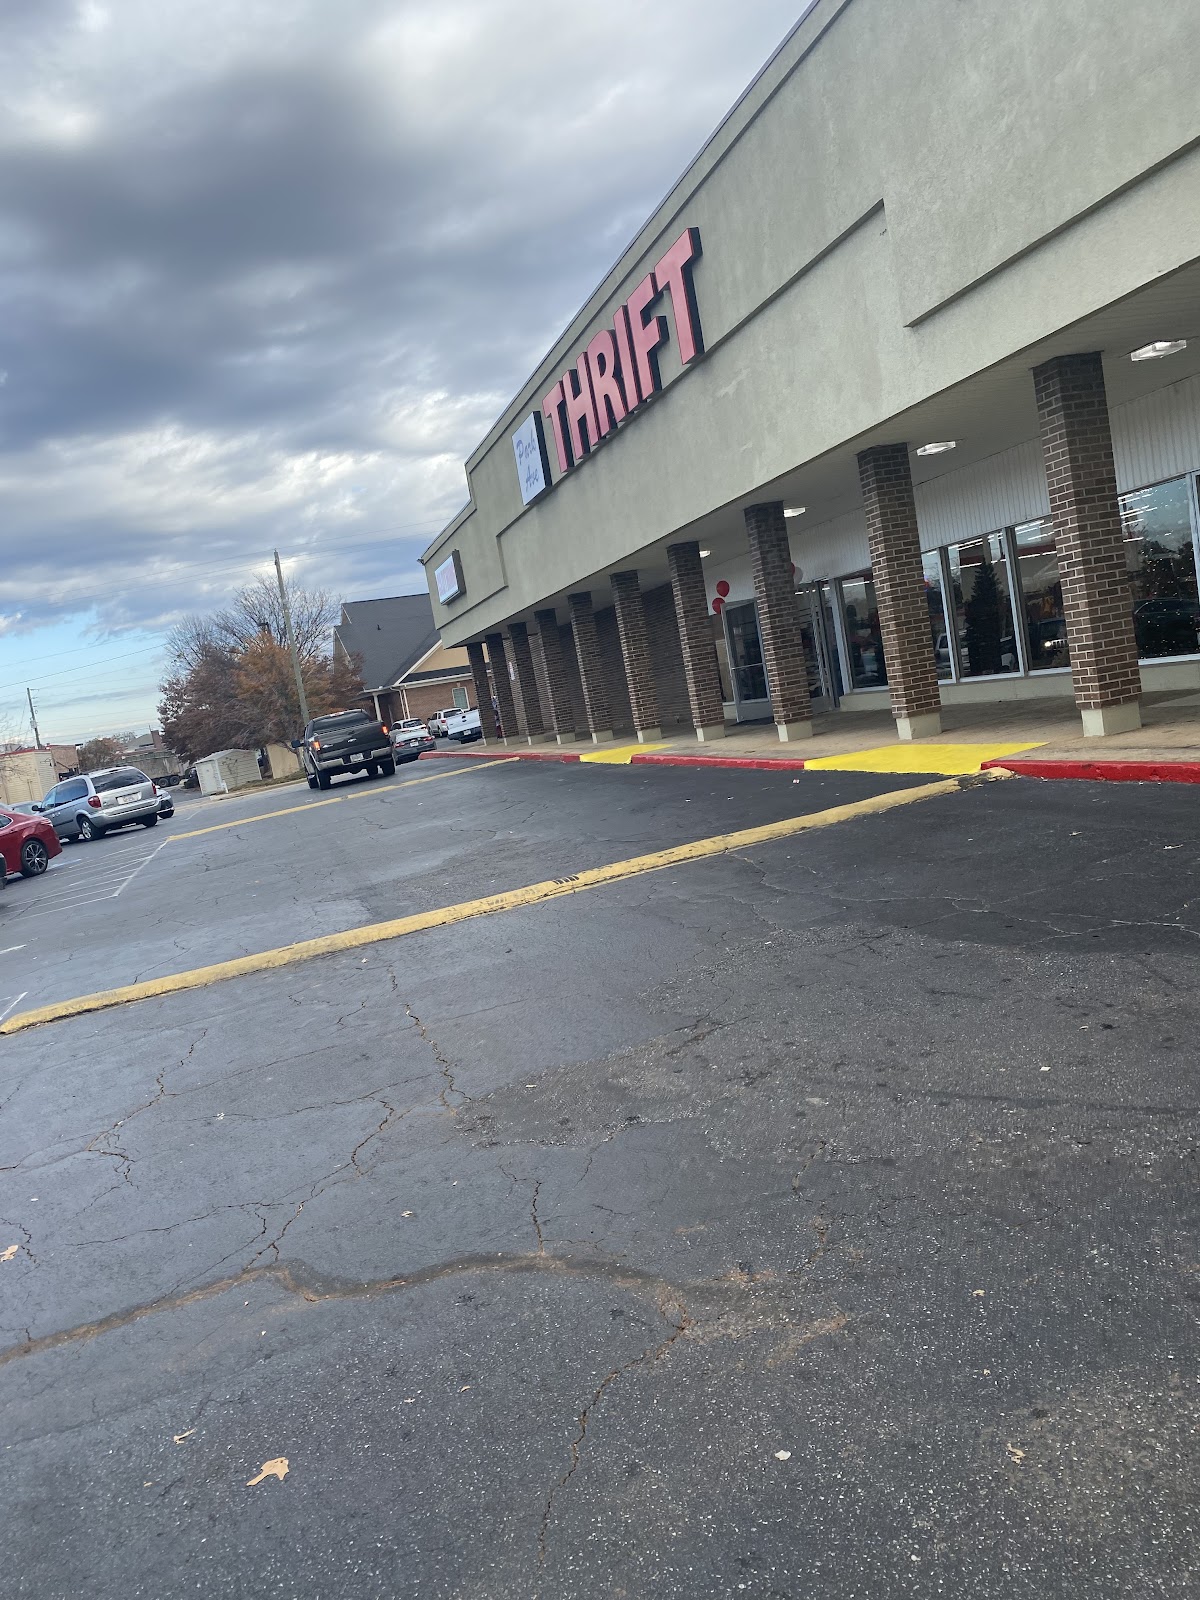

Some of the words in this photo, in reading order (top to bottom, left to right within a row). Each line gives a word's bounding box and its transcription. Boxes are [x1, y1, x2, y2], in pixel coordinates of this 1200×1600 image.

[542, 228, 699, 473] THRIFT
[516, 429, 536, 465] Park
[525, 464, 539, 492] Ave
